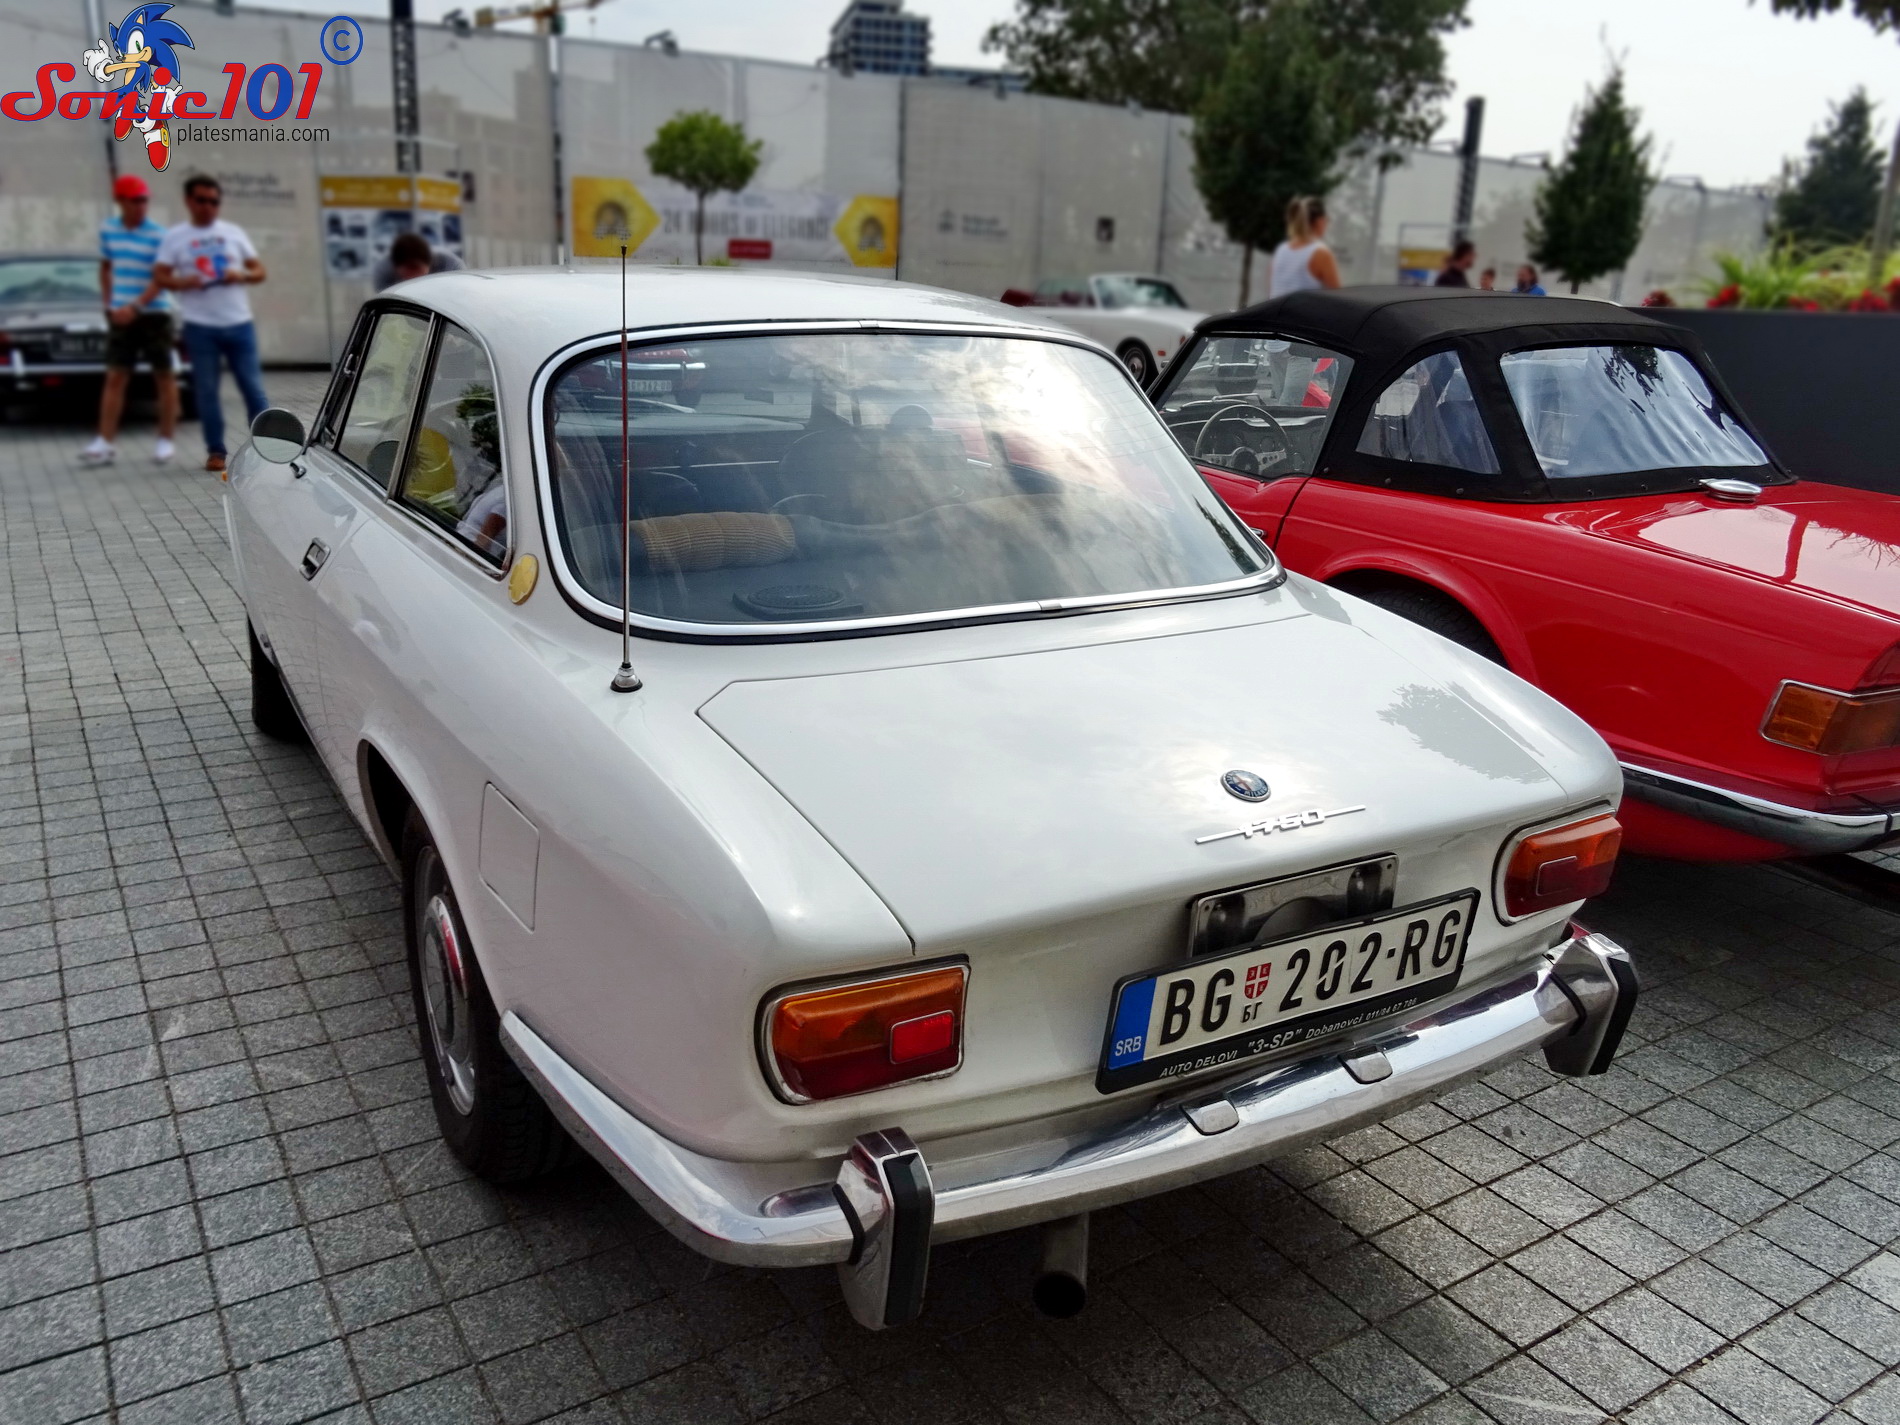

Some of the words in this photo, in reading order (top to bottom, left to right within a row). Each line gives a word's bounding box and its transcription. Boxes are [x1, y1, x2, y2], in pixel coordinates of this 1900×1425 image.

[1239, 809, 1326, 839] 1750
[1159, 968, 1235, 1047] BG
[1114, 1035, 1142, 1057] SRB
[1160, 1061, 1193, 1078] AUTO
[1195, 1050, 1238, 1070] DELOVI
[1248, 1029, 1303, 1054] "3-SP"
[1305, 1013, 1364, 1039] Dobanovci
